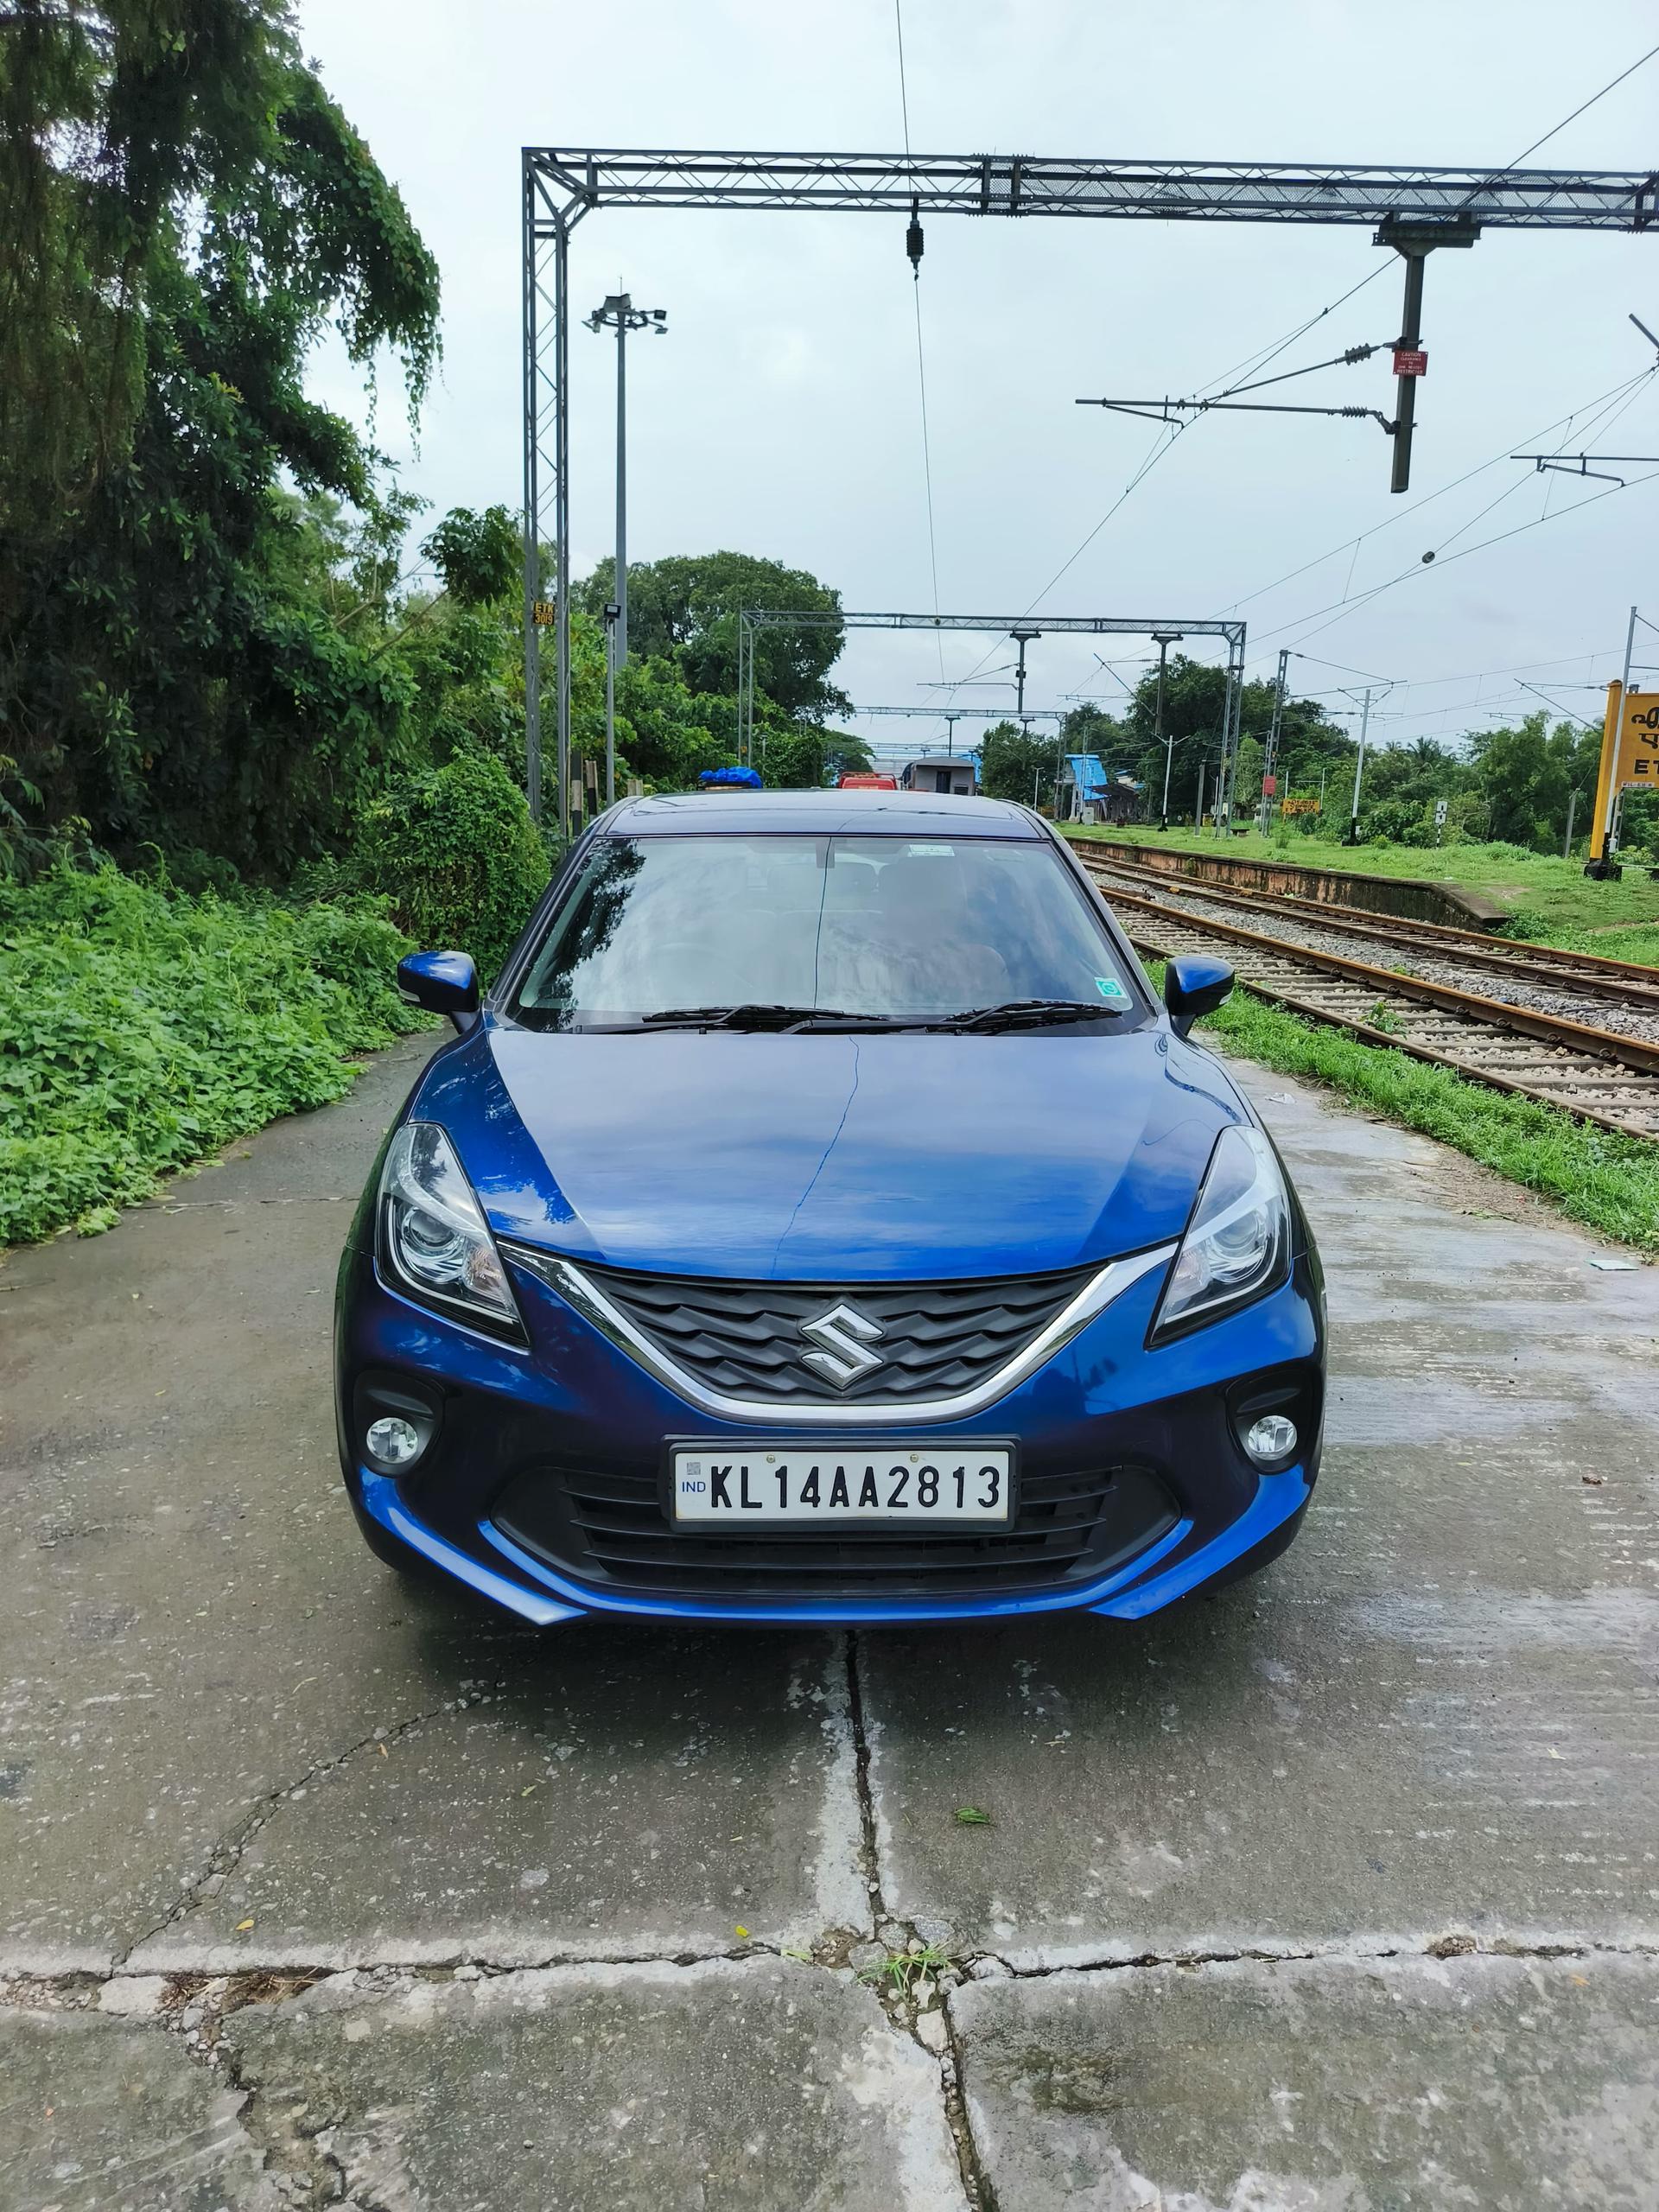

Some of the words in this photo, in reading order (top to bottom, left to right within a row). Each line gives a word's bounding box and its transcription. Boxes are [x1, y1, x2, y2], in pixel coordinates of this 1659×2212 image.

[536, 603, 553, 613] ETK
[535, 614, 552, 625] 3019
[682, 1481, 706, 1493] IND
[710, 1465, 1001, 1509] KL14AA2813
